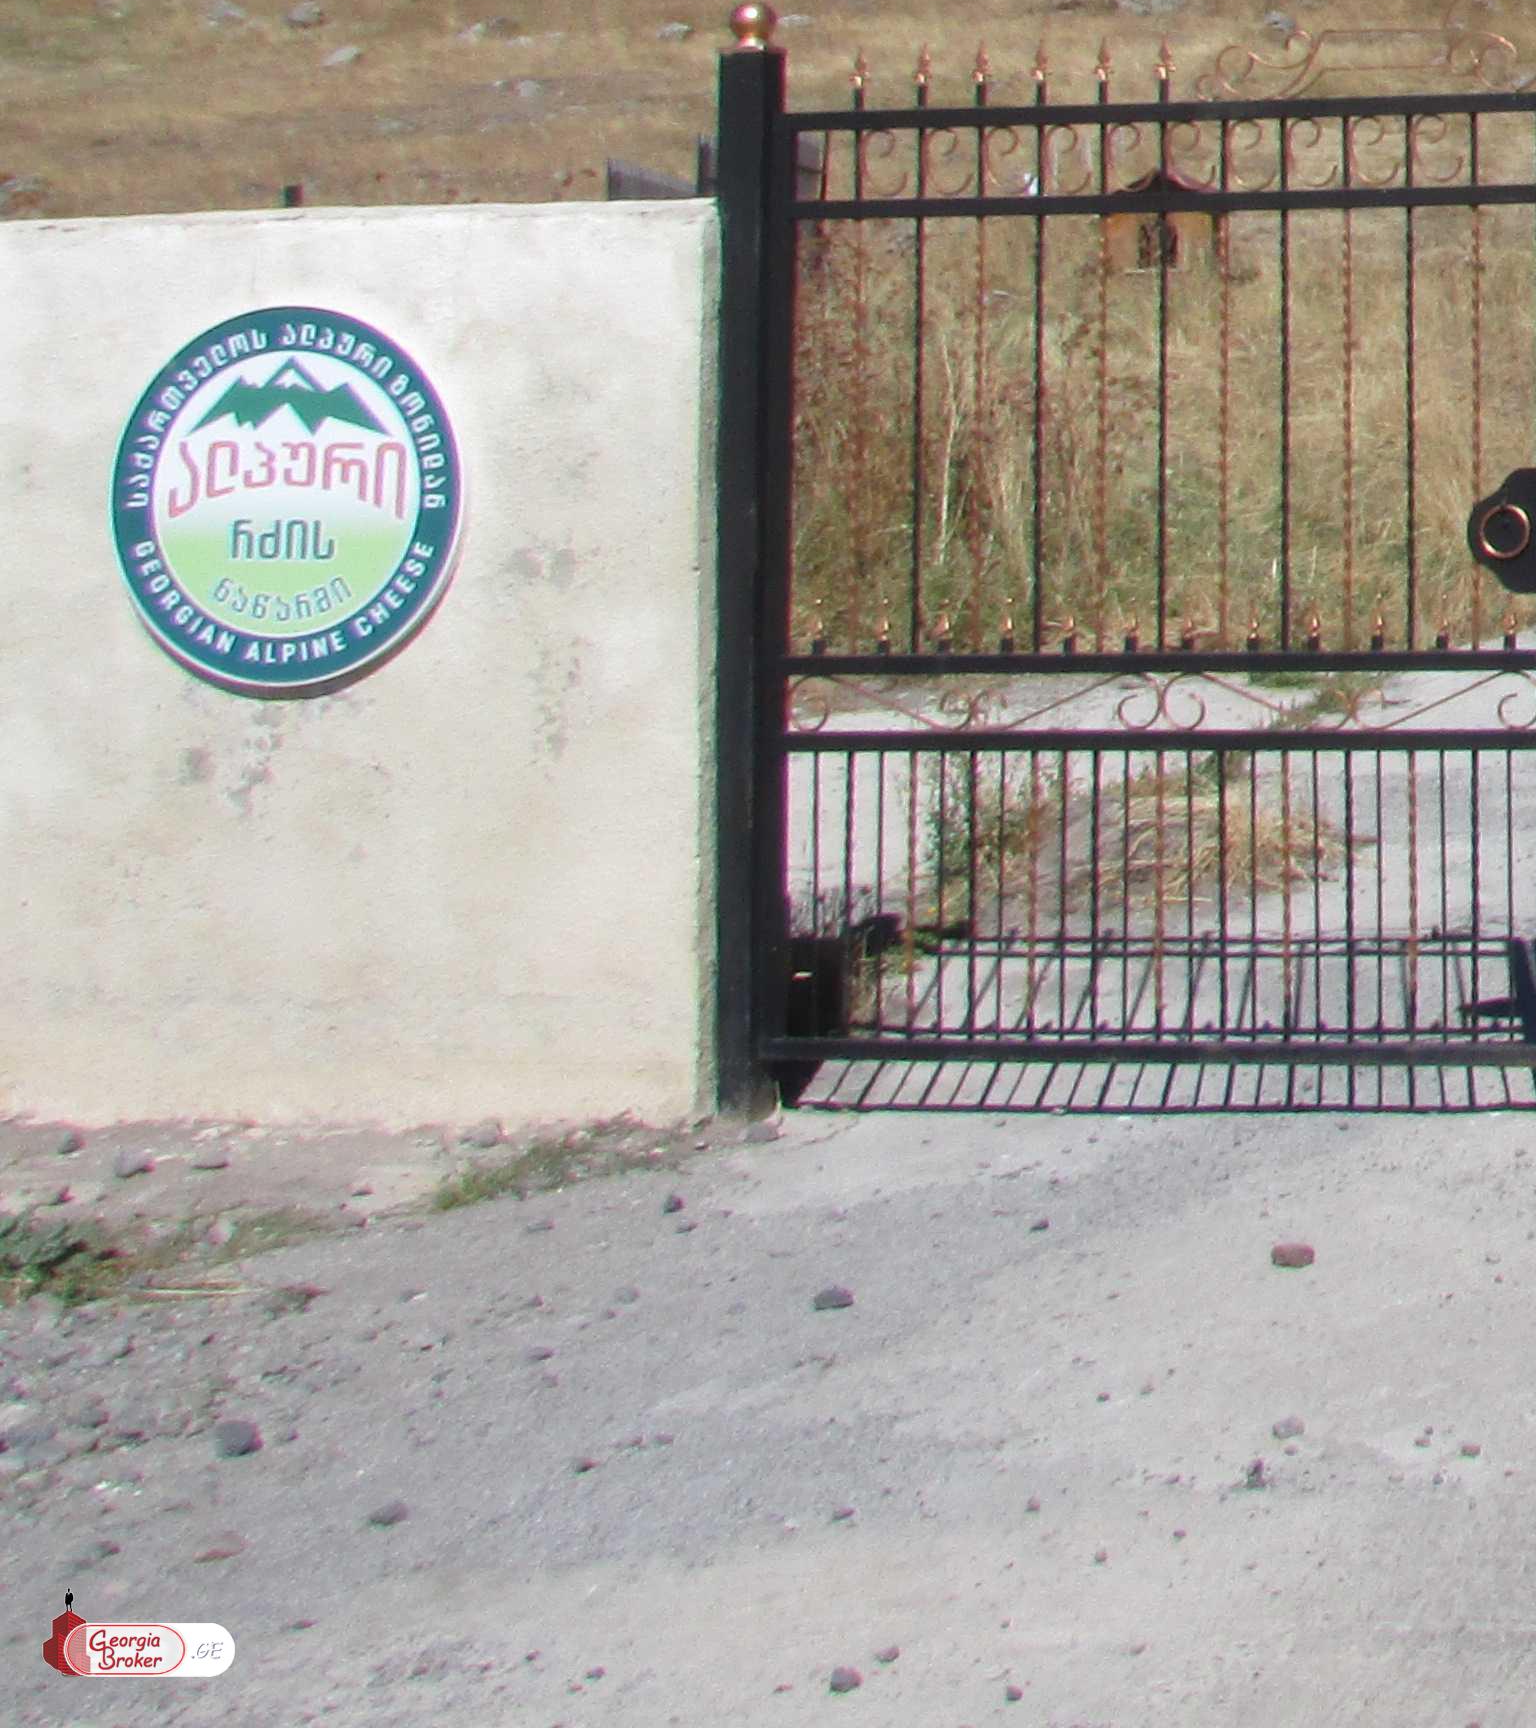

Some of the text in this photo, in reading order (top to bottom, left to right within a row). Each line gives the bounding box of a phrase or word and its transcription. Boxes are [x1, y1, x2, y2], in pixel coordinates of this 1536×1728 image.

[127, 323, 446, 508] საქართველოს ალპური ზონიდან
[168, 440, 407, 519] ალპური
[231, 519, 335, 560] რძის
[134, 541, 434, 663] GEORGIAN ALPINE CHEESE
[213, 577, 352, 621] ნაწარმი
